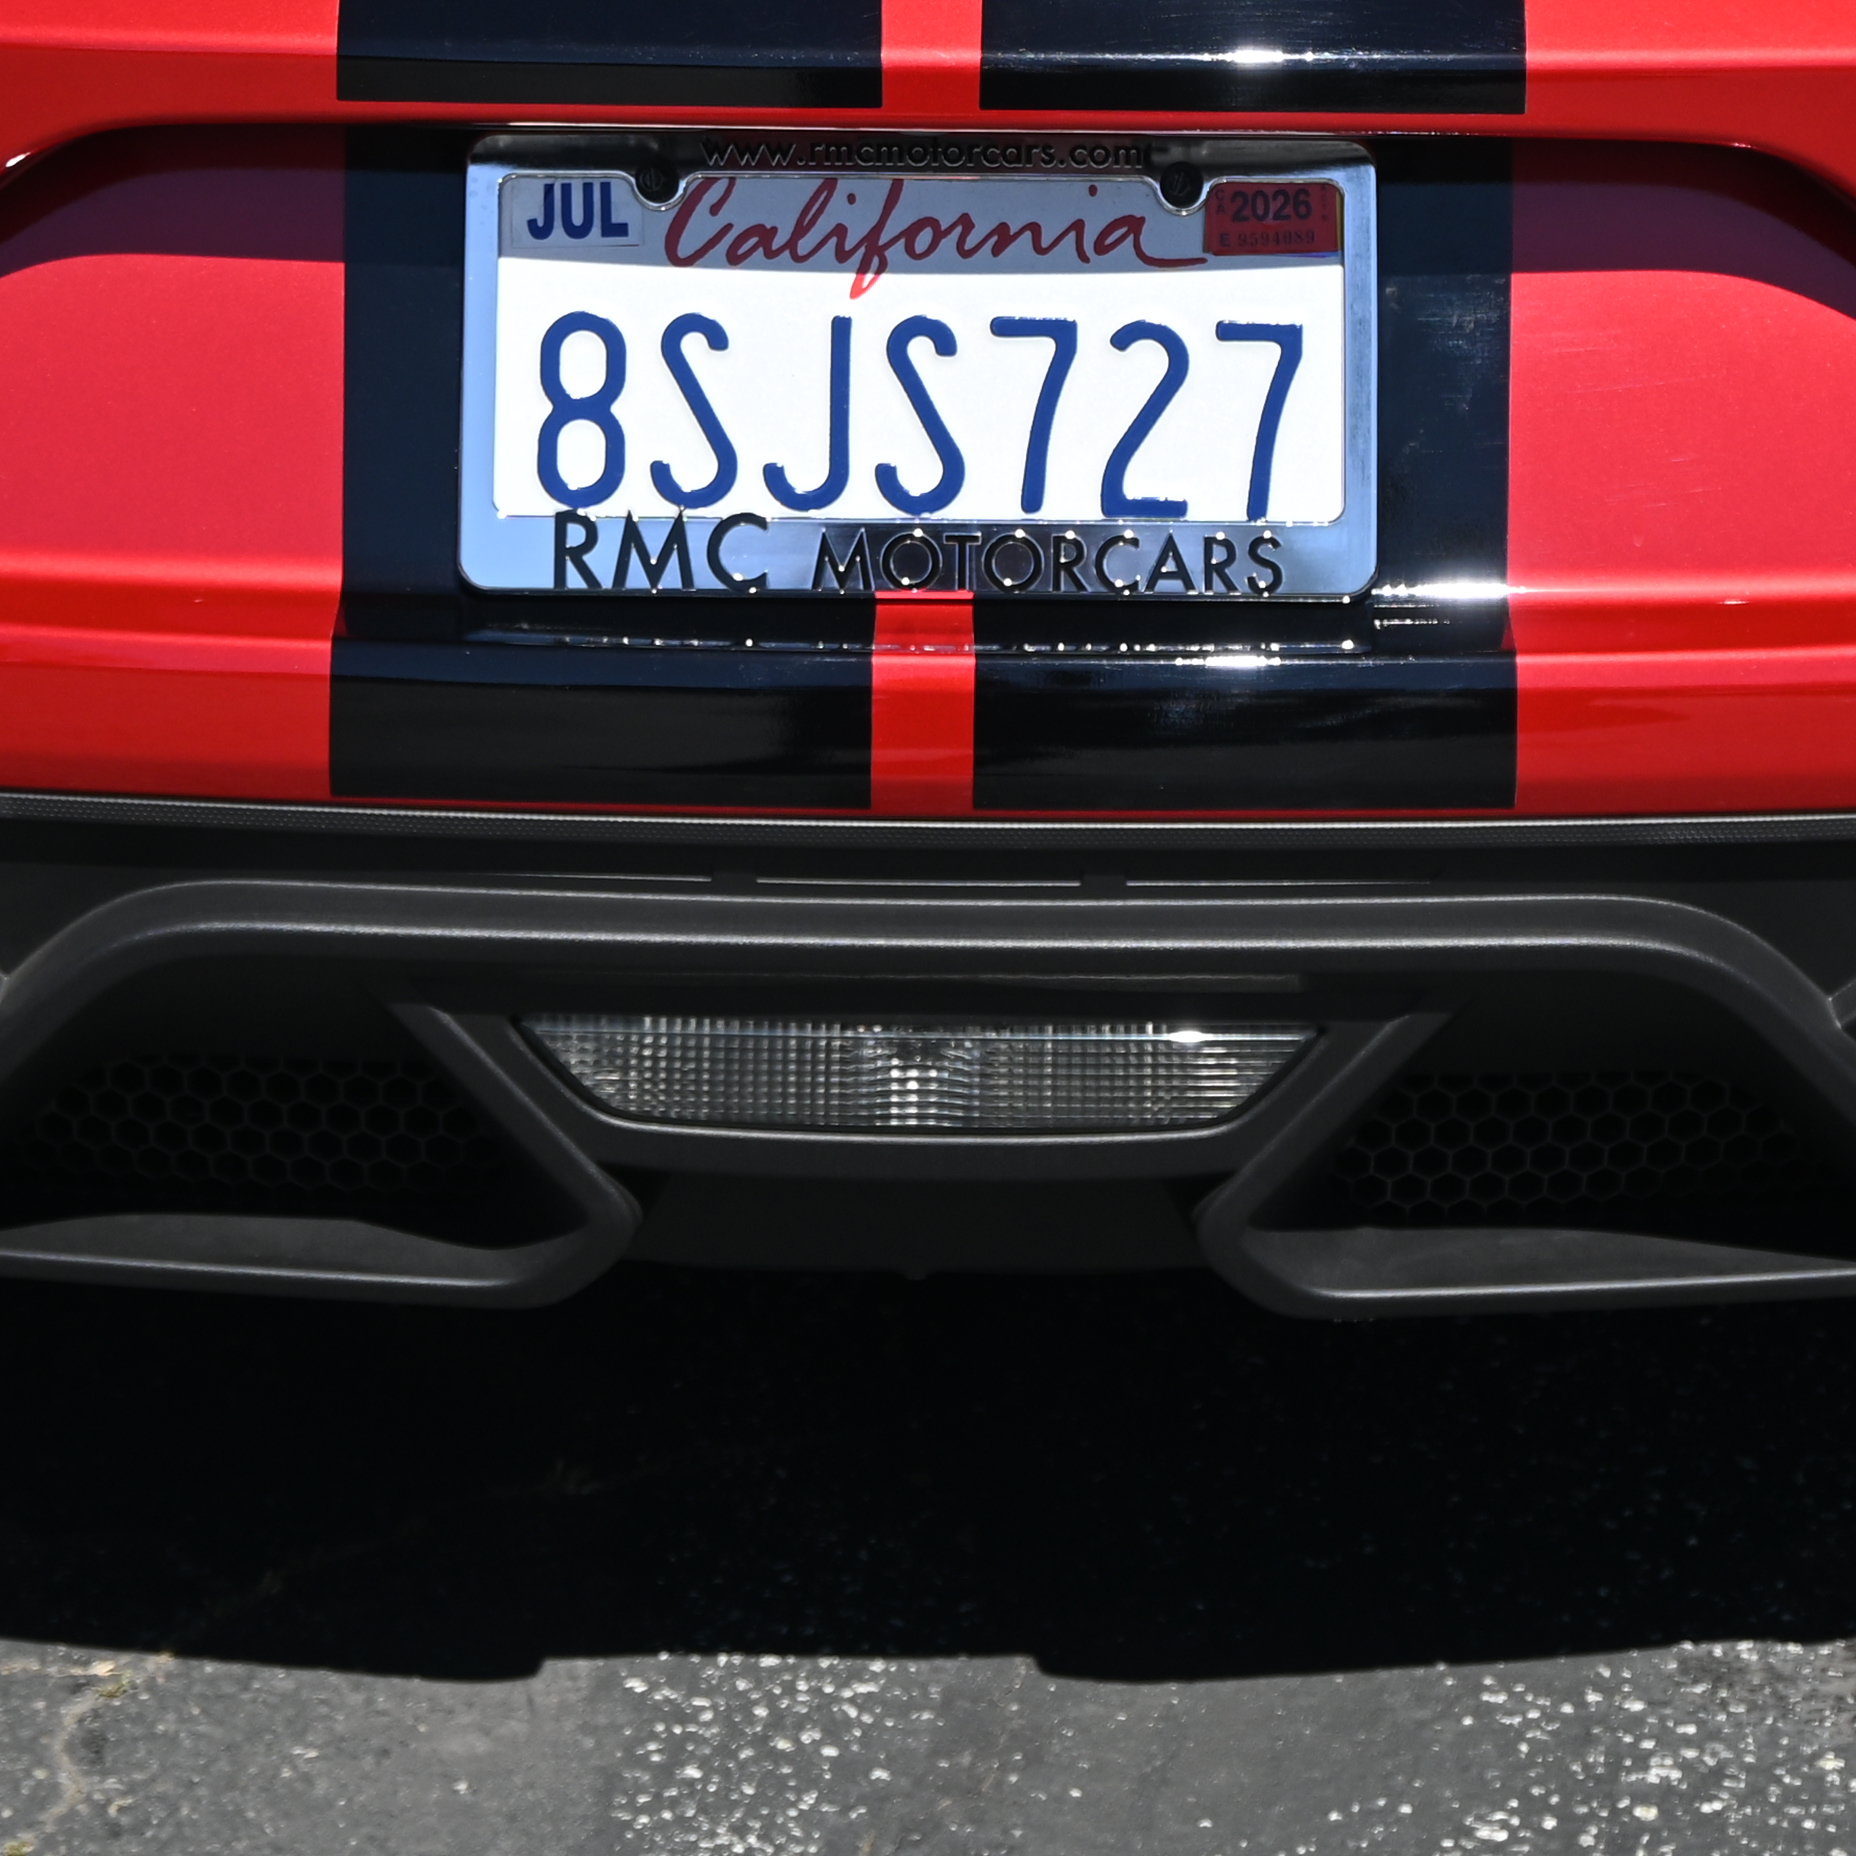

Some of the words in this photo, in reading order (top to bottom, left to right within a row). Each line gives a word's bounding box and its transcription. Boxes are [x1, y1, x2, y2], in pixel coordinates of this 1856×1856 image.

[700, 139, 1143, 169] www.rmcmotorcars.com
[527, 181, 629, 240] JUL
[664, 177, 1208, 300] California
[1230, 188, 1313, 222] 2026
[536, 310, 1304, 522] 8SJS727
[553, 508, 769, 594] RMC
[811, 528, 1284, 596] MOTORCARS
